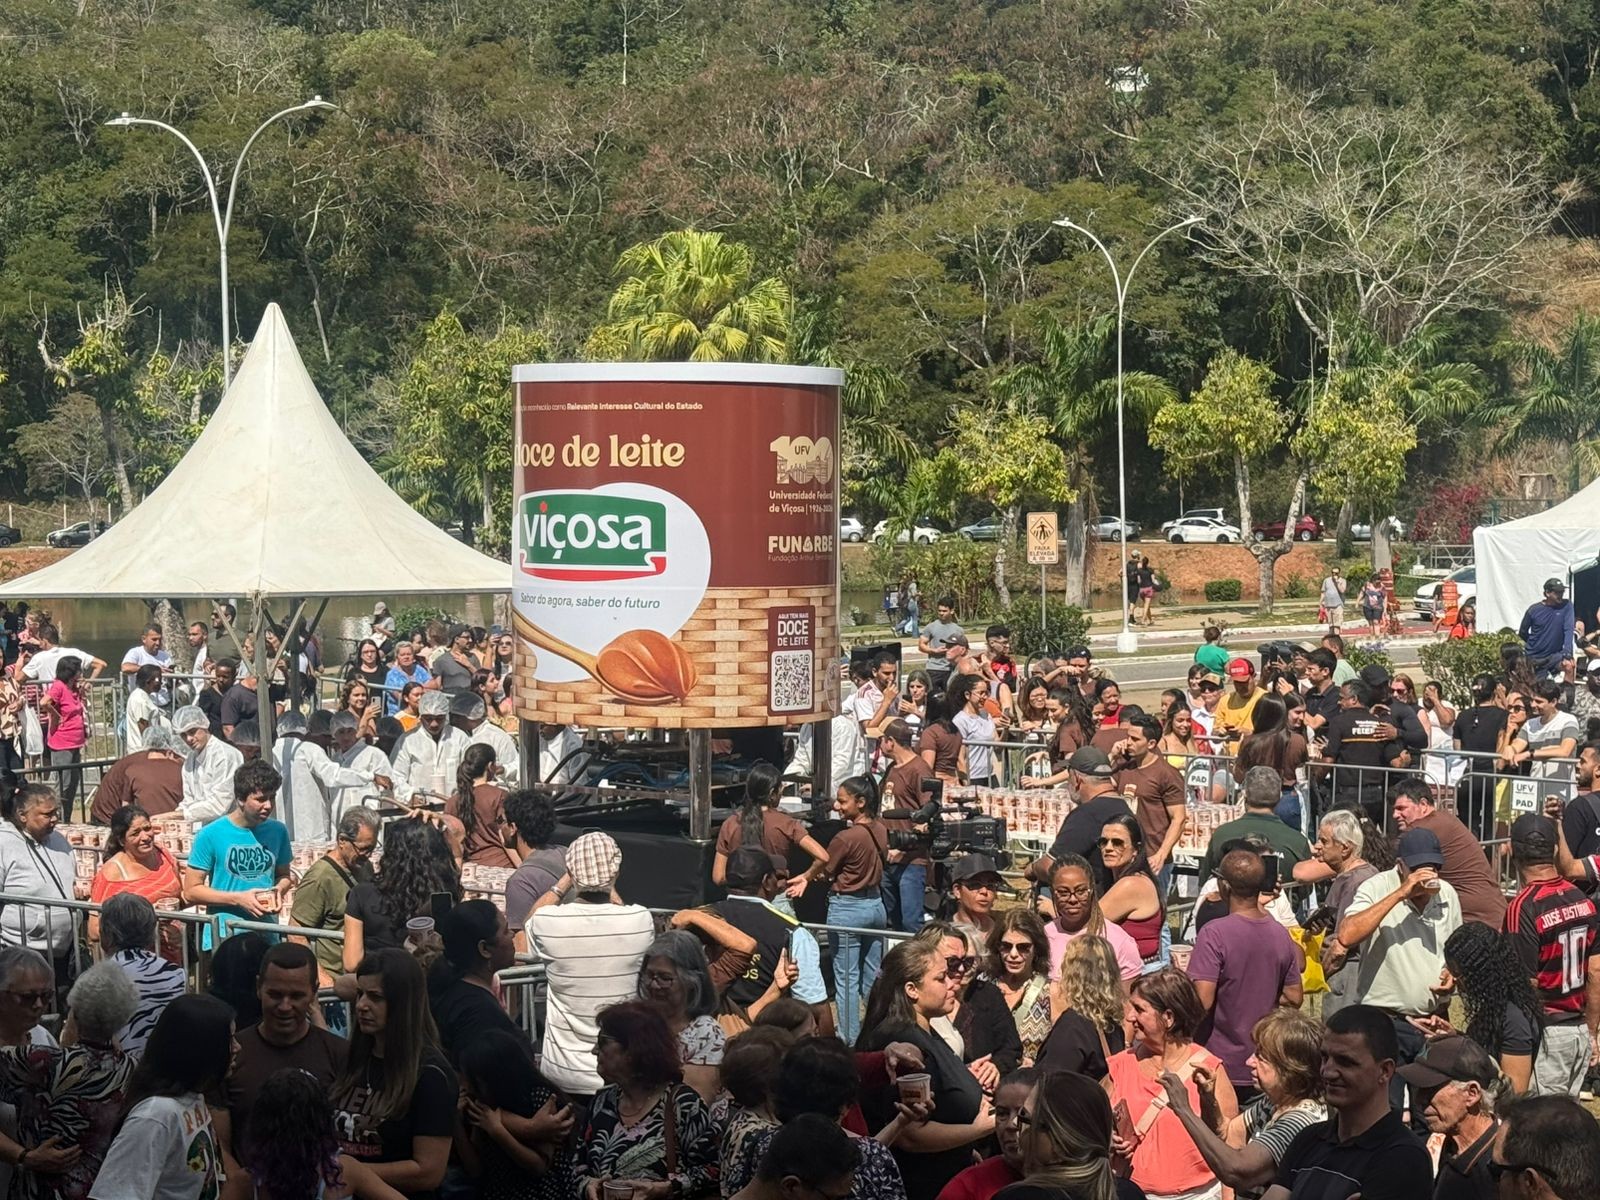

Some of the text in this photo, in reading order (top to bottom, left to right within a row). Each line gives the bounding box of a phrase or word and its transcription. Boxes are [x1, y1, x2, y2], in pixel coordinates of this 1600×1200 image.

[567, 402, 598, 410] Relevante
[599, 402, 632, 410] Interesse
[633, 402, 663, 410] Cultural
[665, 402, 675, 410] do
[676, 402, 703, 410] Estado
[514, 433, 685, 468] doce de leite
[794, 445, 810, 455] UFV
[769, 435, 834, 485] 100
[769, 490, 816, 500] Universidade
[769, 503, 780, 513] de
[781, 503, 805, 515] Viçosa
[523, 501, 652, 560] viçosa
[520, 592, 661, 609] Sabor do agora, saber do futuro
[777, 619, 809, 636] DOCE
[777, 636, 809, 647] DE LEITE
[1191, 775, 1207, 783] PAD
[1516, 783, 1534, 793] UFV
[1515, 799, 1534, 808] PAD
[1541, 908, 1563, 929] JOSÉ
[1558, 924, 1590, 994] 10
